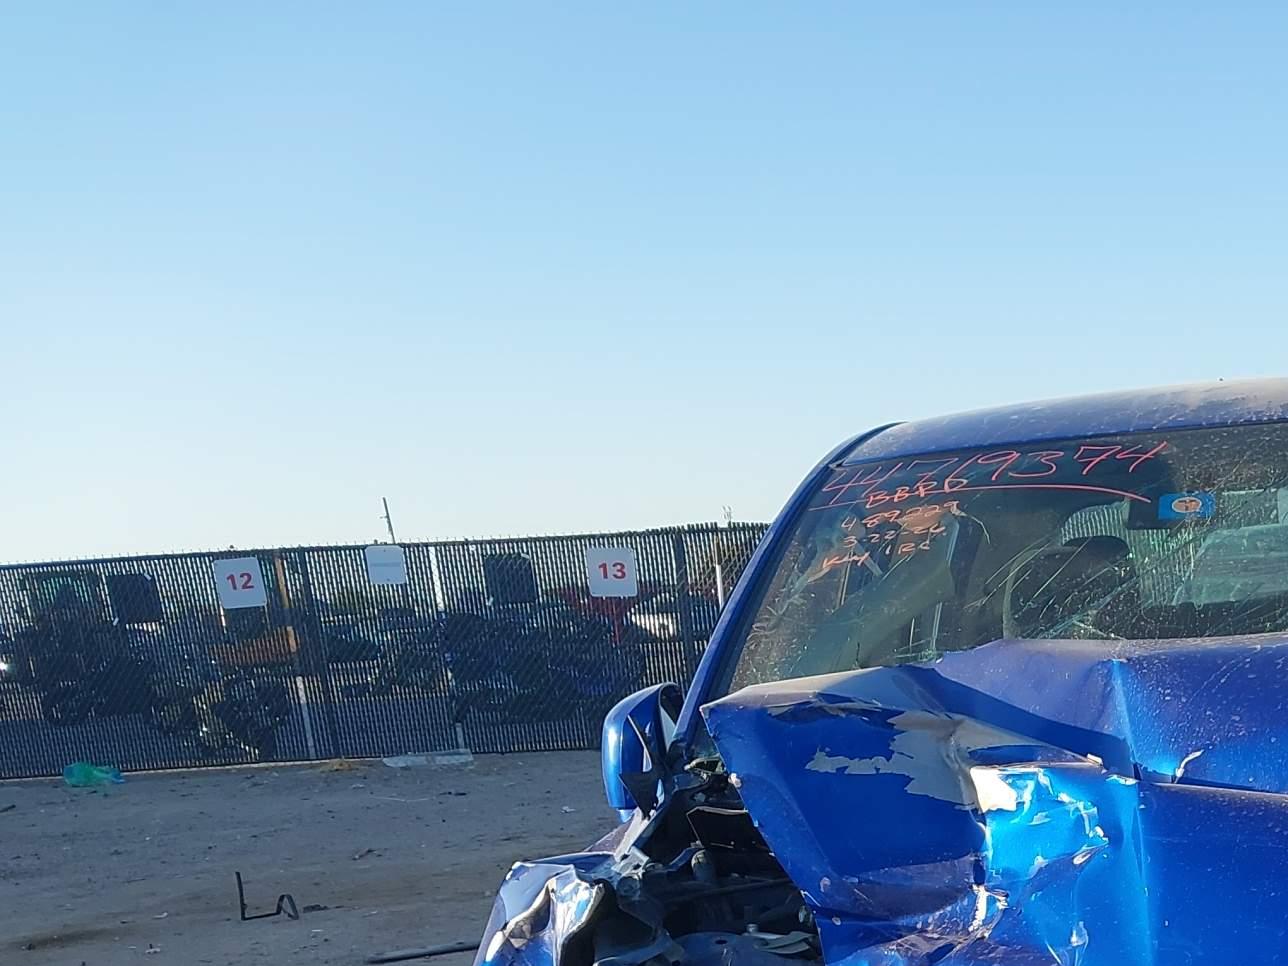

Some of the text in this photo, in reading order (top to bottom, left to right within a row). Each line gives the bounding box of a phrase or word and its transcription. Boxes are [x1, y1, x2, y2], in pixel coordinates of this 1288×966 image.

[822, 440, 1169, 506] 44719374
[598, 562, 626, 580] 13
[226, 572, 255, 591] 12
